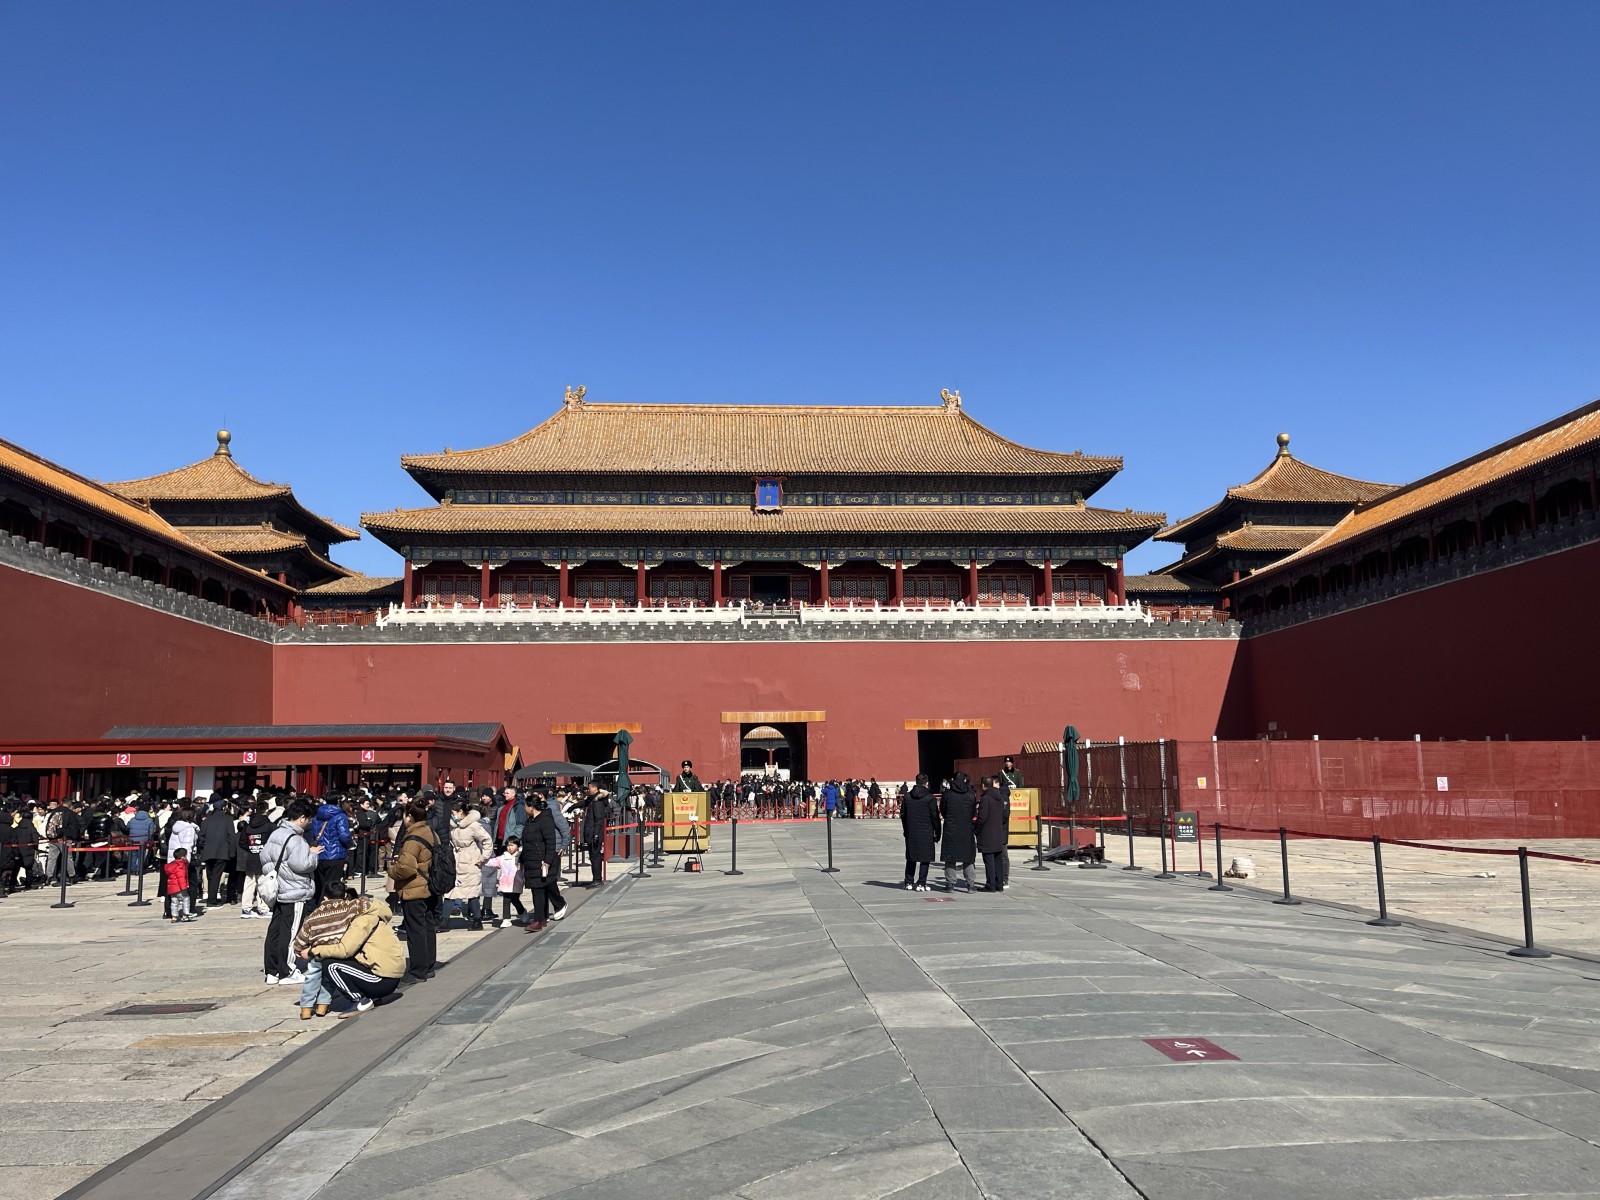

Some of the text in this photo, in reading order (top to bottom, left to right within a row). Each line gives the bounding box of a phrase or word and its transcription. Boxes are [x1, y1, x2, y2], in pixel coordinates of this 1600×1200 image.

[120, 754, 127, 764] 2
[246, 752, 254, 762] 3
[364, 751, 372, 760] 4
